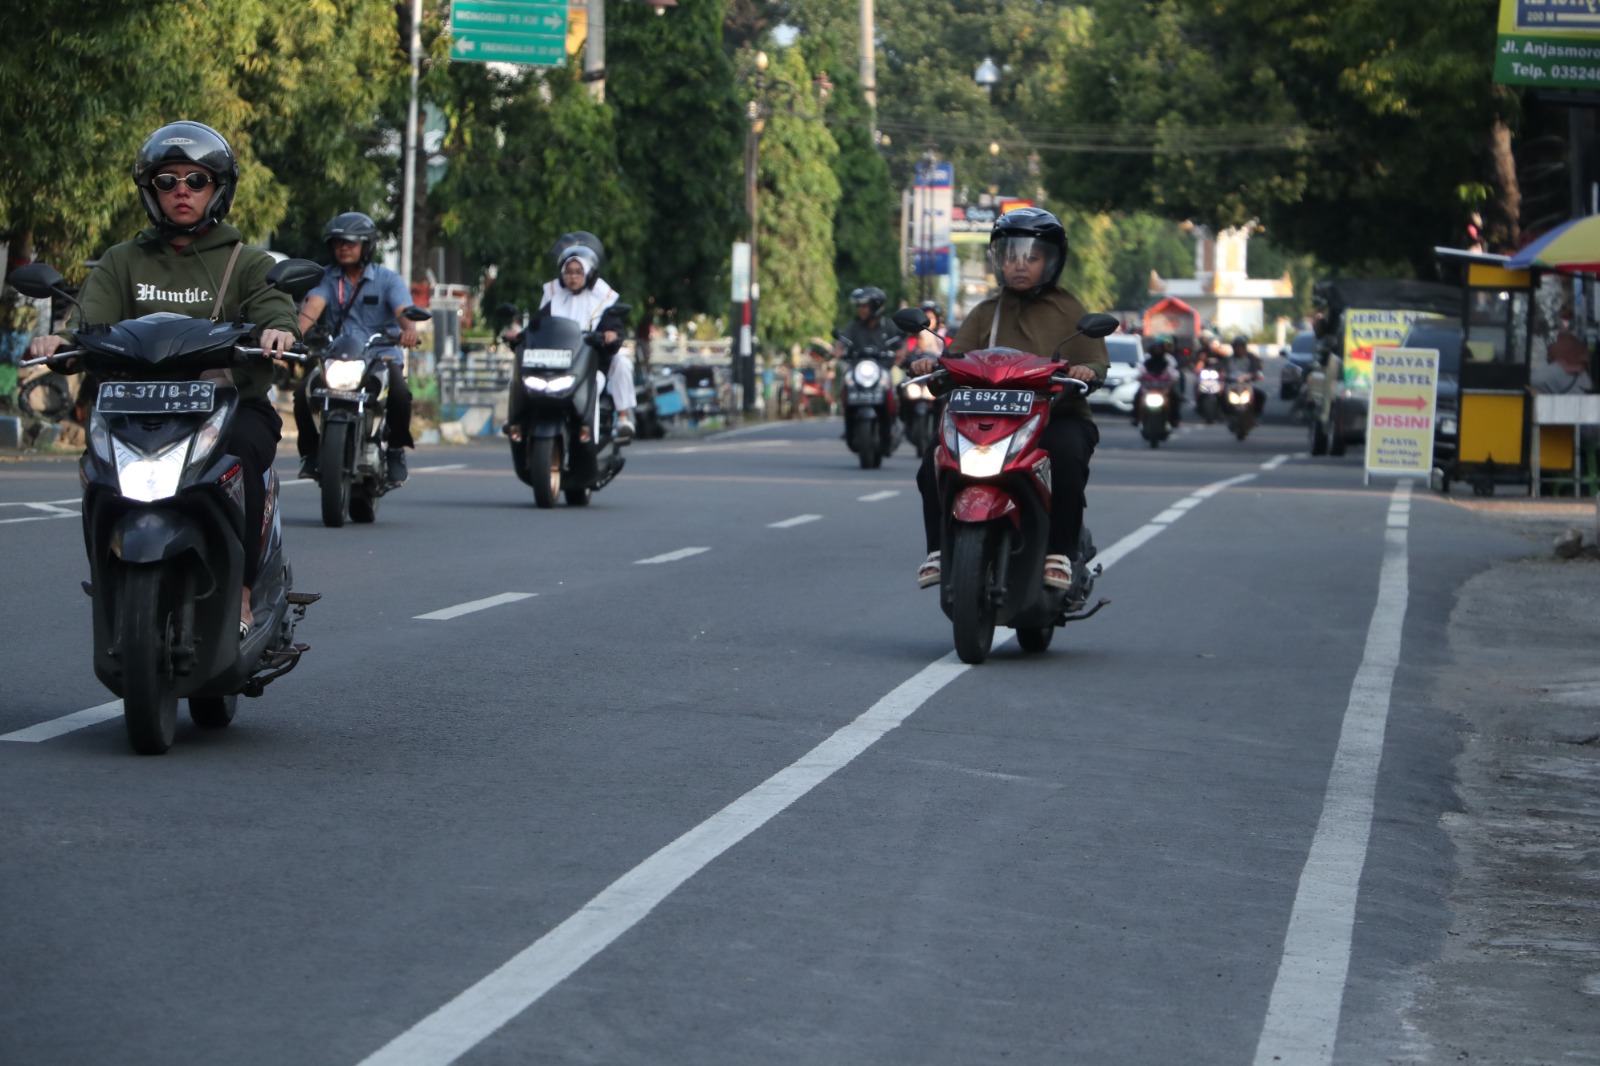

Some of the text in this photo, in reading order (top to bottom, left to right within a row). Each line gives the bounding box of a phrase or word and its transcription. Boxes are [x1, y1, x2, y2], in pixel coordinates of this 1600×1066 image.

[1527, 11, 1544, 22] 200
[1501, 40, 1519, 54] Jl.
[1511, 62, 1546, 80] Telp.
[136, 283, 213, 303] Humble.
[1375, 355, 1435, 369] DJAYAS
[1376, 372, 1432, 386] PASTEL
[132, 385, 180, 398] 3718
[189, 384, 211, 398] PS
[954, 391, 971, 401] AE
[975, 391, 1007, 402] 6947
[1373, 413, 1431, 430] DISINI
